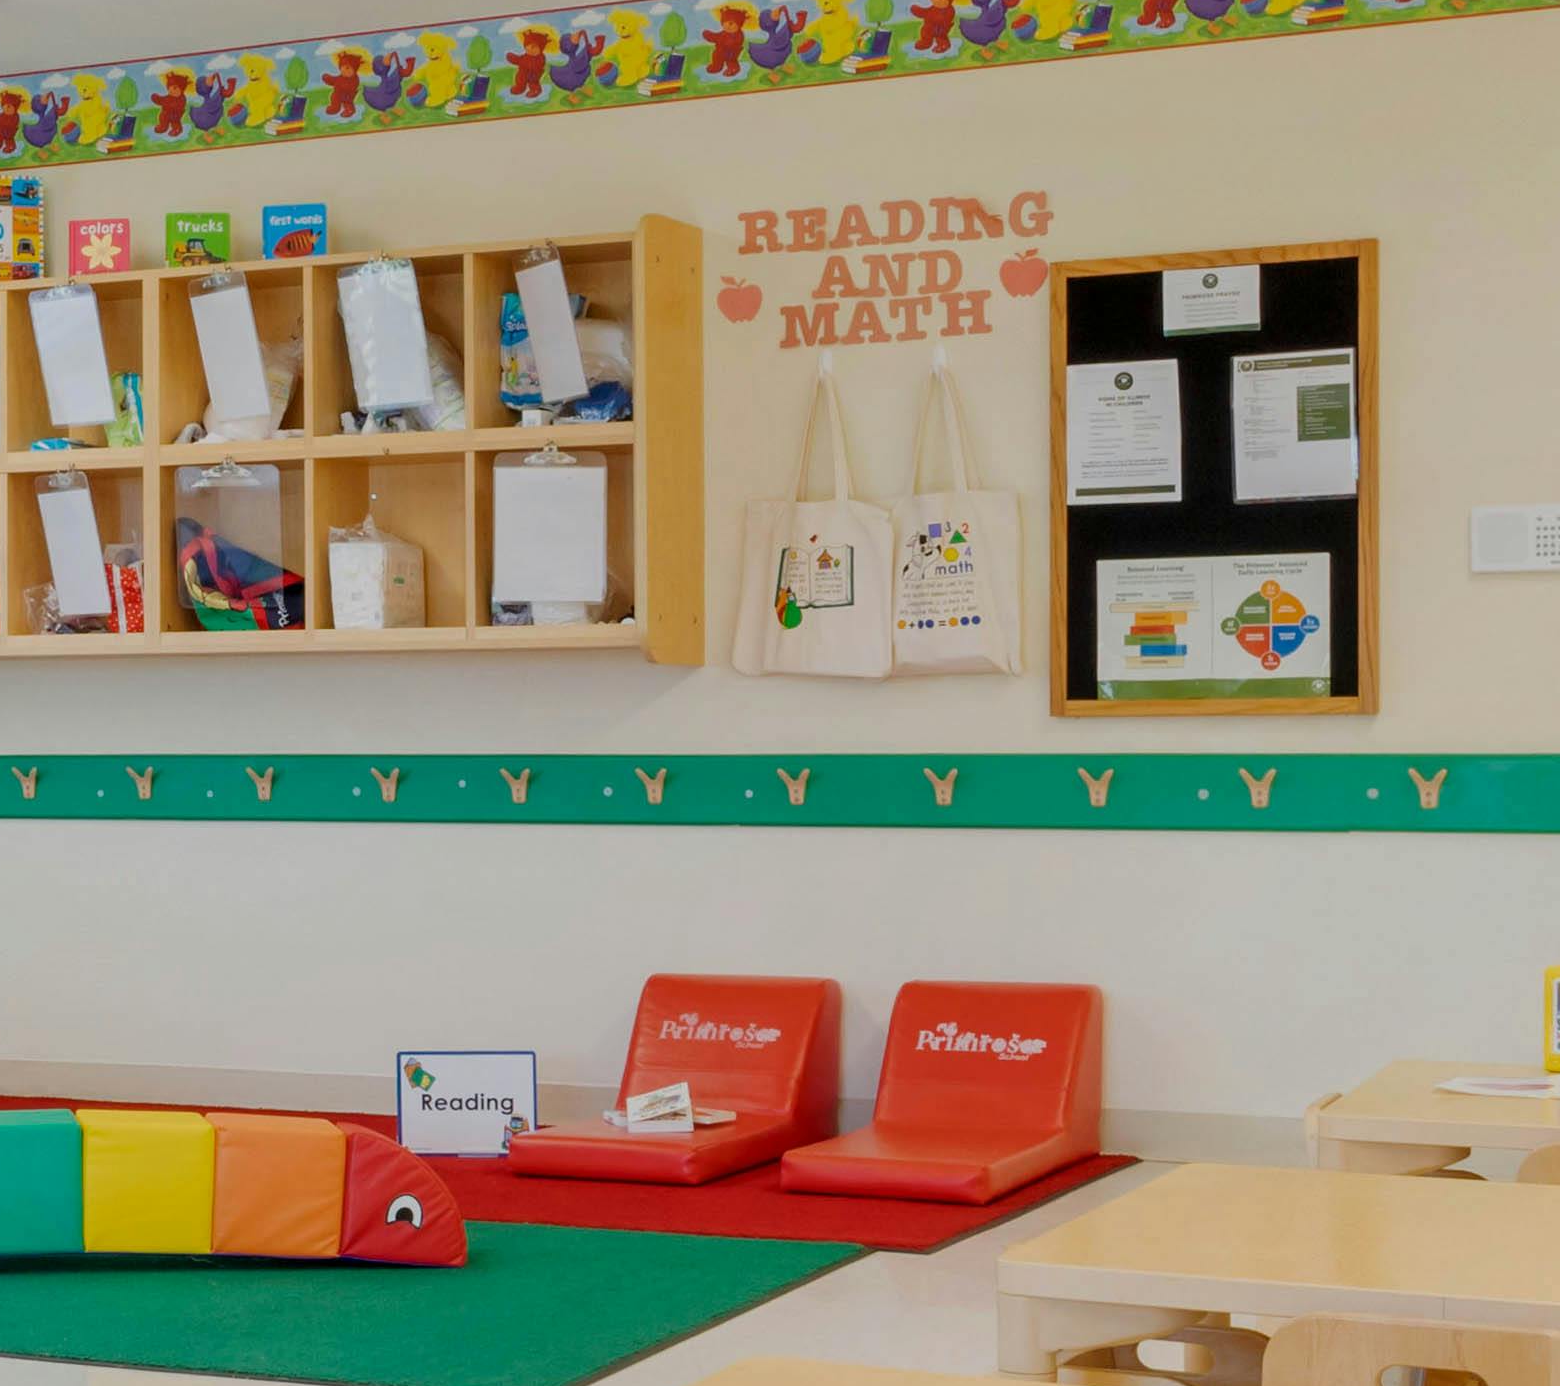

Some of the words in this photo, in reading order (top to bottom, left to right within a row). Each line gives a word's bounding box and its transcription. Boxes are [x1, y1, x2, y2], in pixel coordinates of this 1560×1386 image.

[79, 220, 125, 237] colors
[176, 219, 225, 233] trucks
[270, 215, 292, 227] first
[738, 191, 1055, 255] READING
[811, 249, 963, 299] AND
[779, 289, 993, 349] MATH
[943, 521, 953, 534] 3
[961, 522, 970, 534] 2
[964, 546, 973, 557] 4
[934, 560, 975, 576] math
[421, 1092, 514, 1115] Reading
